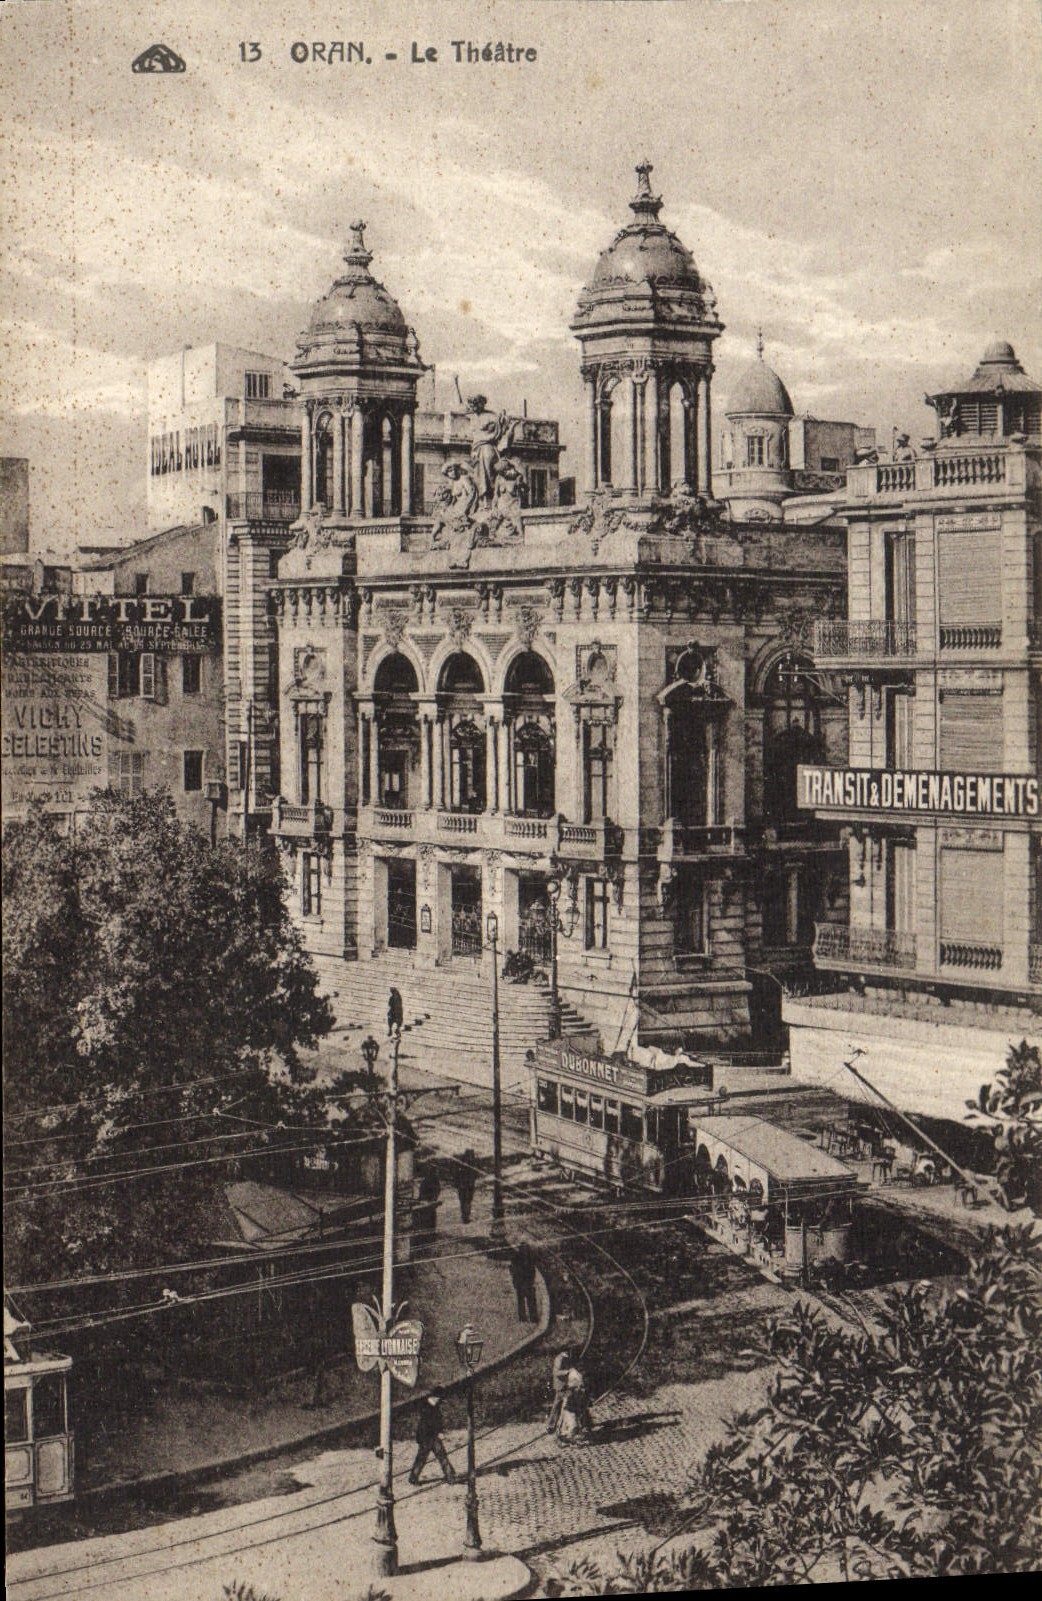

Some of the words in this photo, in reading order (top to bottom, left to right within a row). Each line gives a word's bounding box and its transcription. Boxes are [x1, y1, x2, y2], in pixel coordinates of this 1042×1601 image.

[25, 595, 209, 622] VITTEL
[20, 624, 62, 637] GRANDE
[69, 624, 112, 637] SOURCE
[125, 625, 171, 638] SOURCE
[15, 704, 83, 729] VICHY
[803, 769, 871, 807] TRANSIT
[871, 782, 880, 807] &
[561, 1053, 619, 1083] DUBONNET
